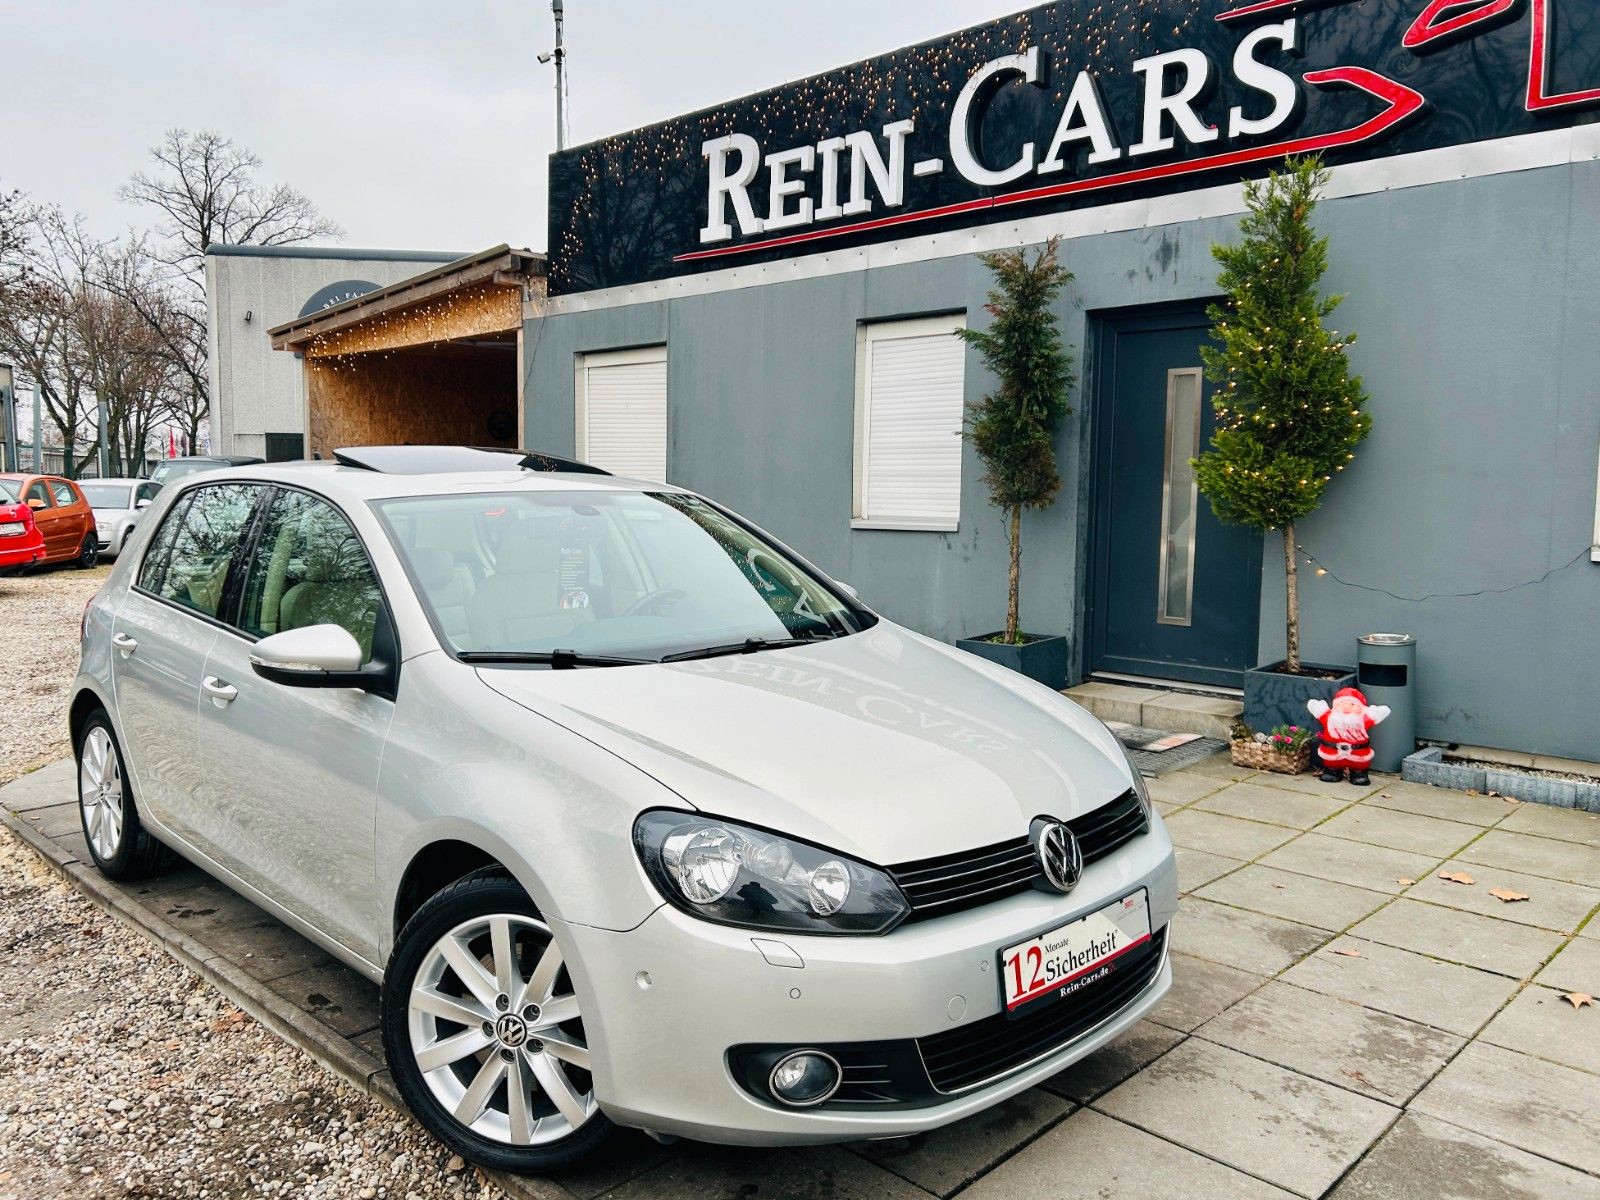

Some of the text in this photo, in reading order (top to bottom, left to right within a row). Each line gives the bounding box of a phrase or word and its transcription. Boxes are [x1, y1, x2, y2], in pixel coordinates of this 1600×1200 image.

[1008, 938, 1069, 999] 12 Monate
[1060, 966, 1109, 997] Rein-Cars.de
